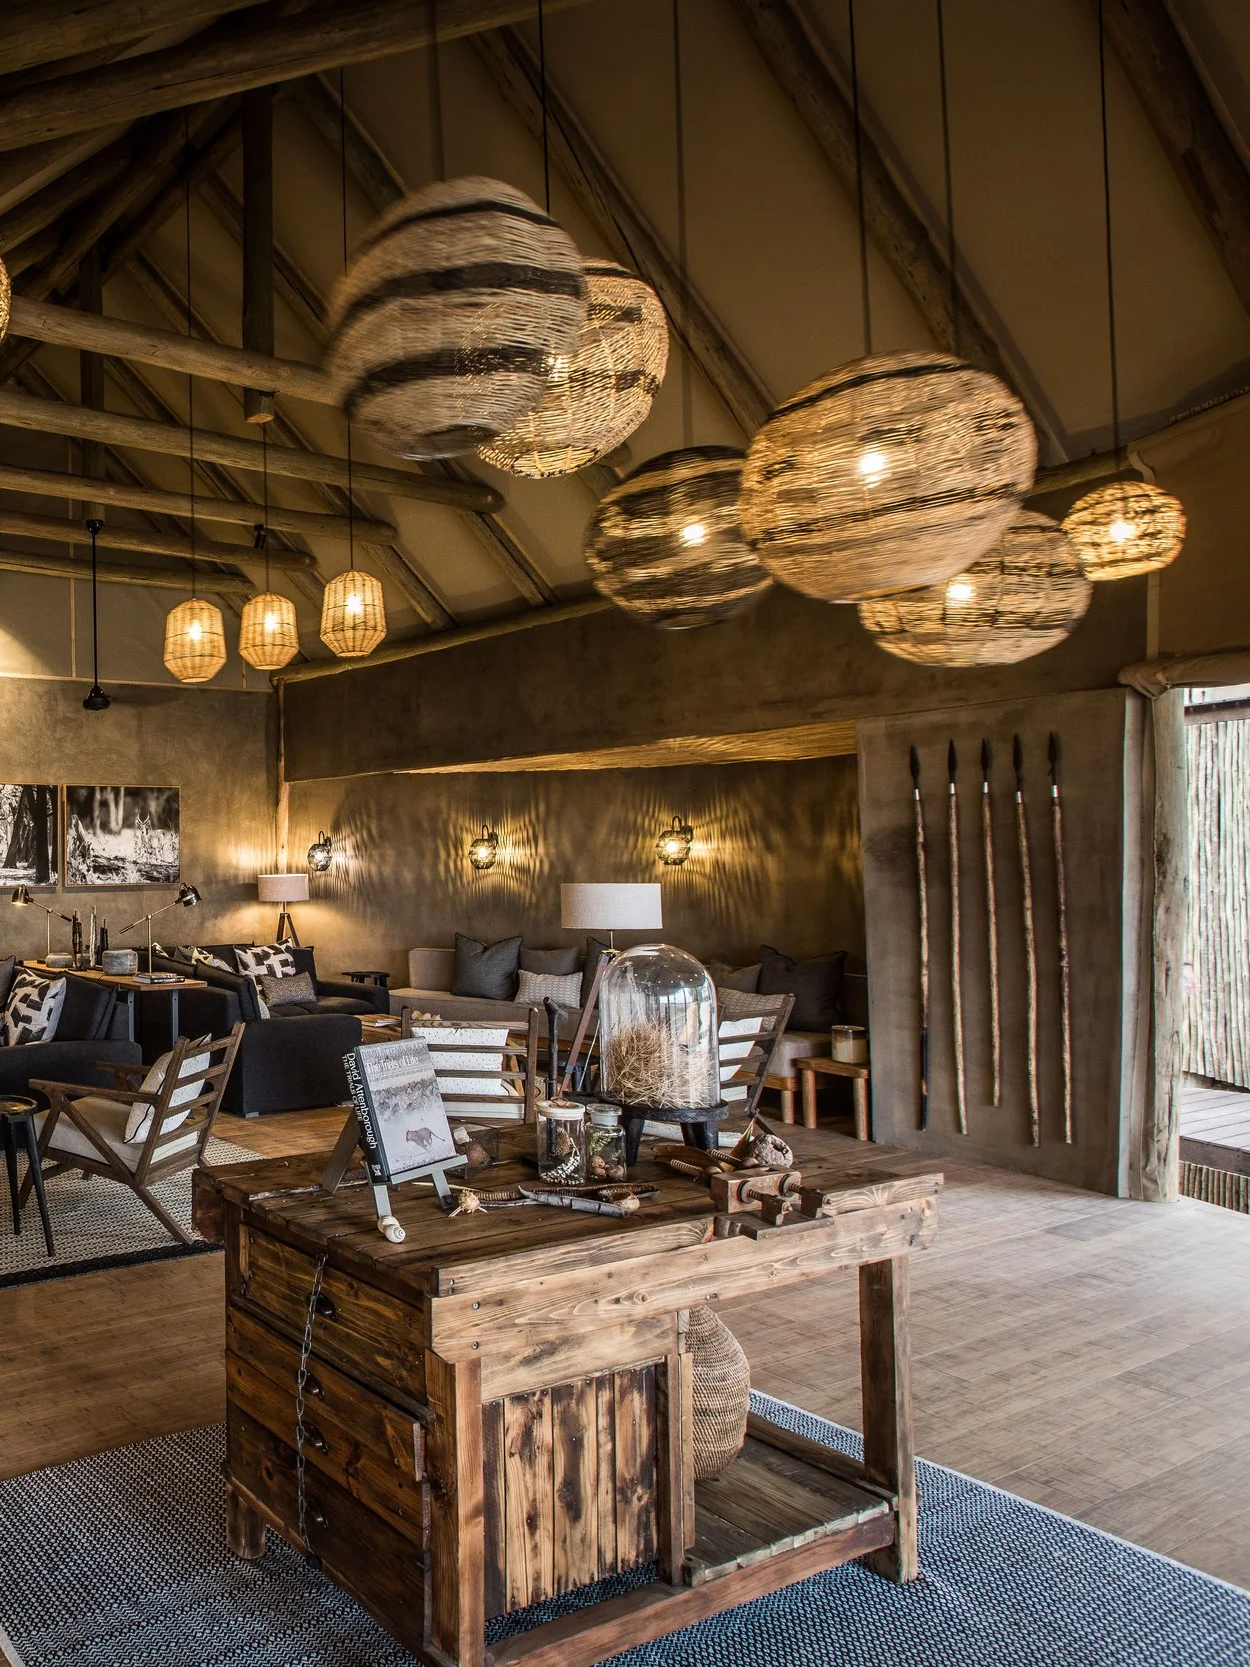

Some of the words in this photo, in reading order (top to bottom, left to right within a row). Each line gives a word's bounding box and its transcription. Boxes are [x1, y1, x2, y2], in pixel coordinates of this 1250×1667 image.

[365, 1062, 381, 1073] The
[380, 1058, 399, 1071] Trials
[399, 1056, 407, 1068] of
[406, 1055, 419, 1066] Life
[346, 1070, 355, 1095] TRIALS
[346, 1052, 361, 1081] David
[354, 1083, 378, 1149] Attenborough
[352, 1095, 359, 1105] OF
[355, 1106, 363, 1121] LIFE
